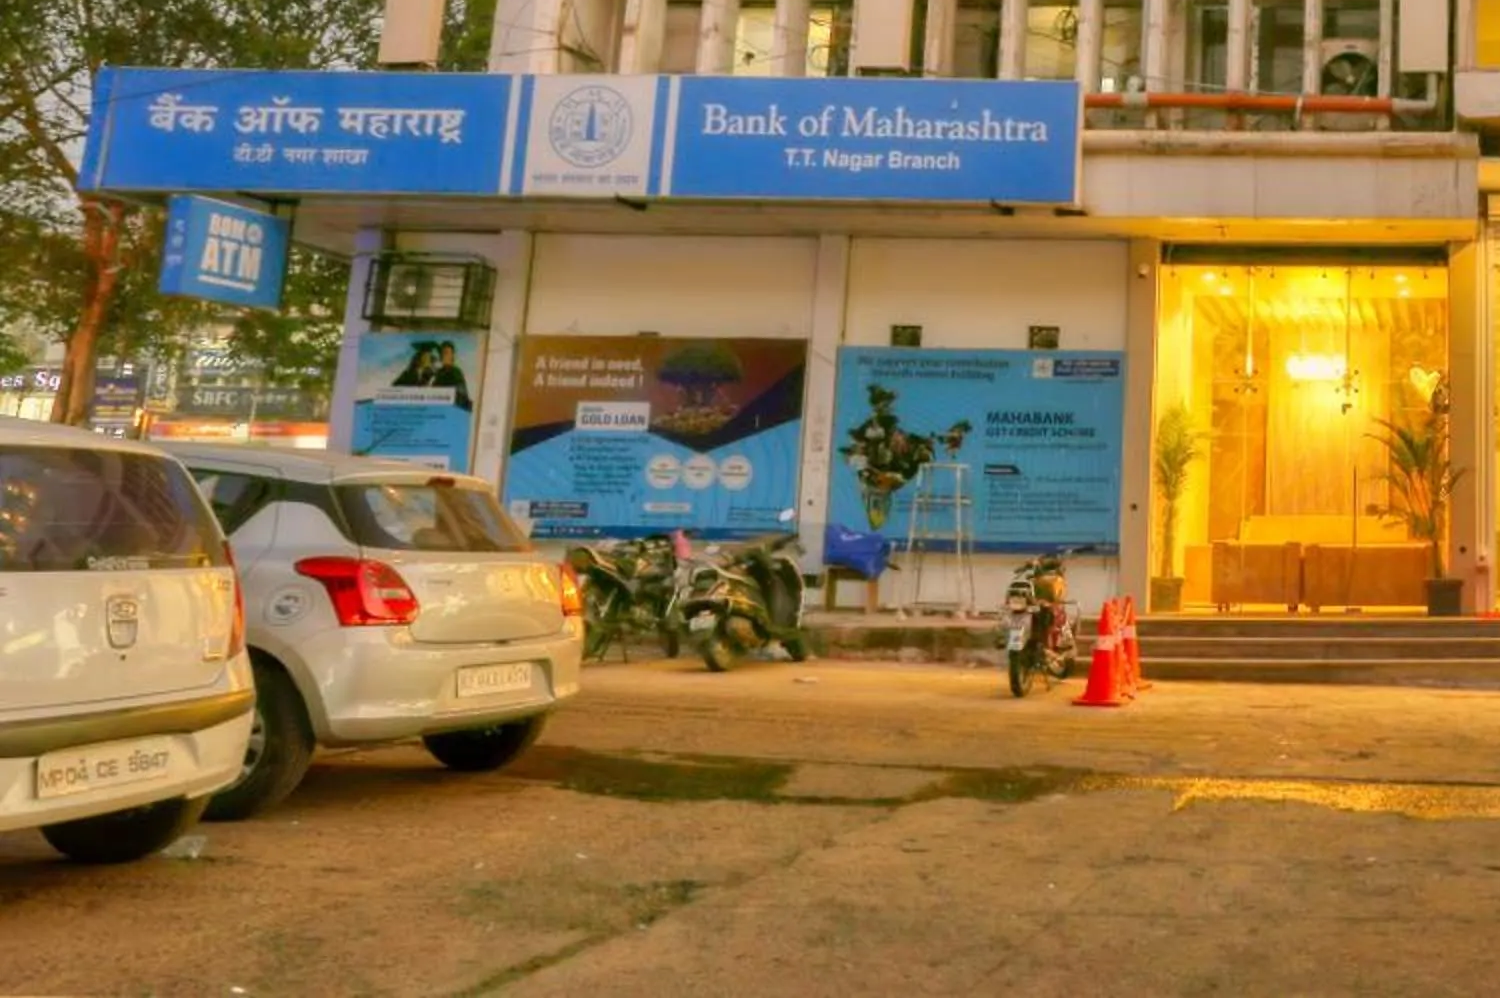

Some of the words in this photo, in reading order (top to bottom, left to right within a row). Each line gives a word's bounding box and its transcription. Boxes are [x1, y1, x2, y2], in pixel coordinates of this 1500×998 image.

[148, 93, 218, 132] बैंक
[234, 95, 323, 133] ऑफ
[338, 107, 465, 144] महाराष्ट्र
[702, 103, 788, 136] Bank
[798, 104, 836, 138] of
[841, 106, 1049, 143] Maharashtra
[784, 148, 817, 168] T.T.
[823, 148, 883, 172] Nagar
[888, 150, 961, 171] Branch
[200, 236, 262, 282] ATM
[986, 411, 1074, 425] MAHABANK
[96, 759, 119, 779] CE
